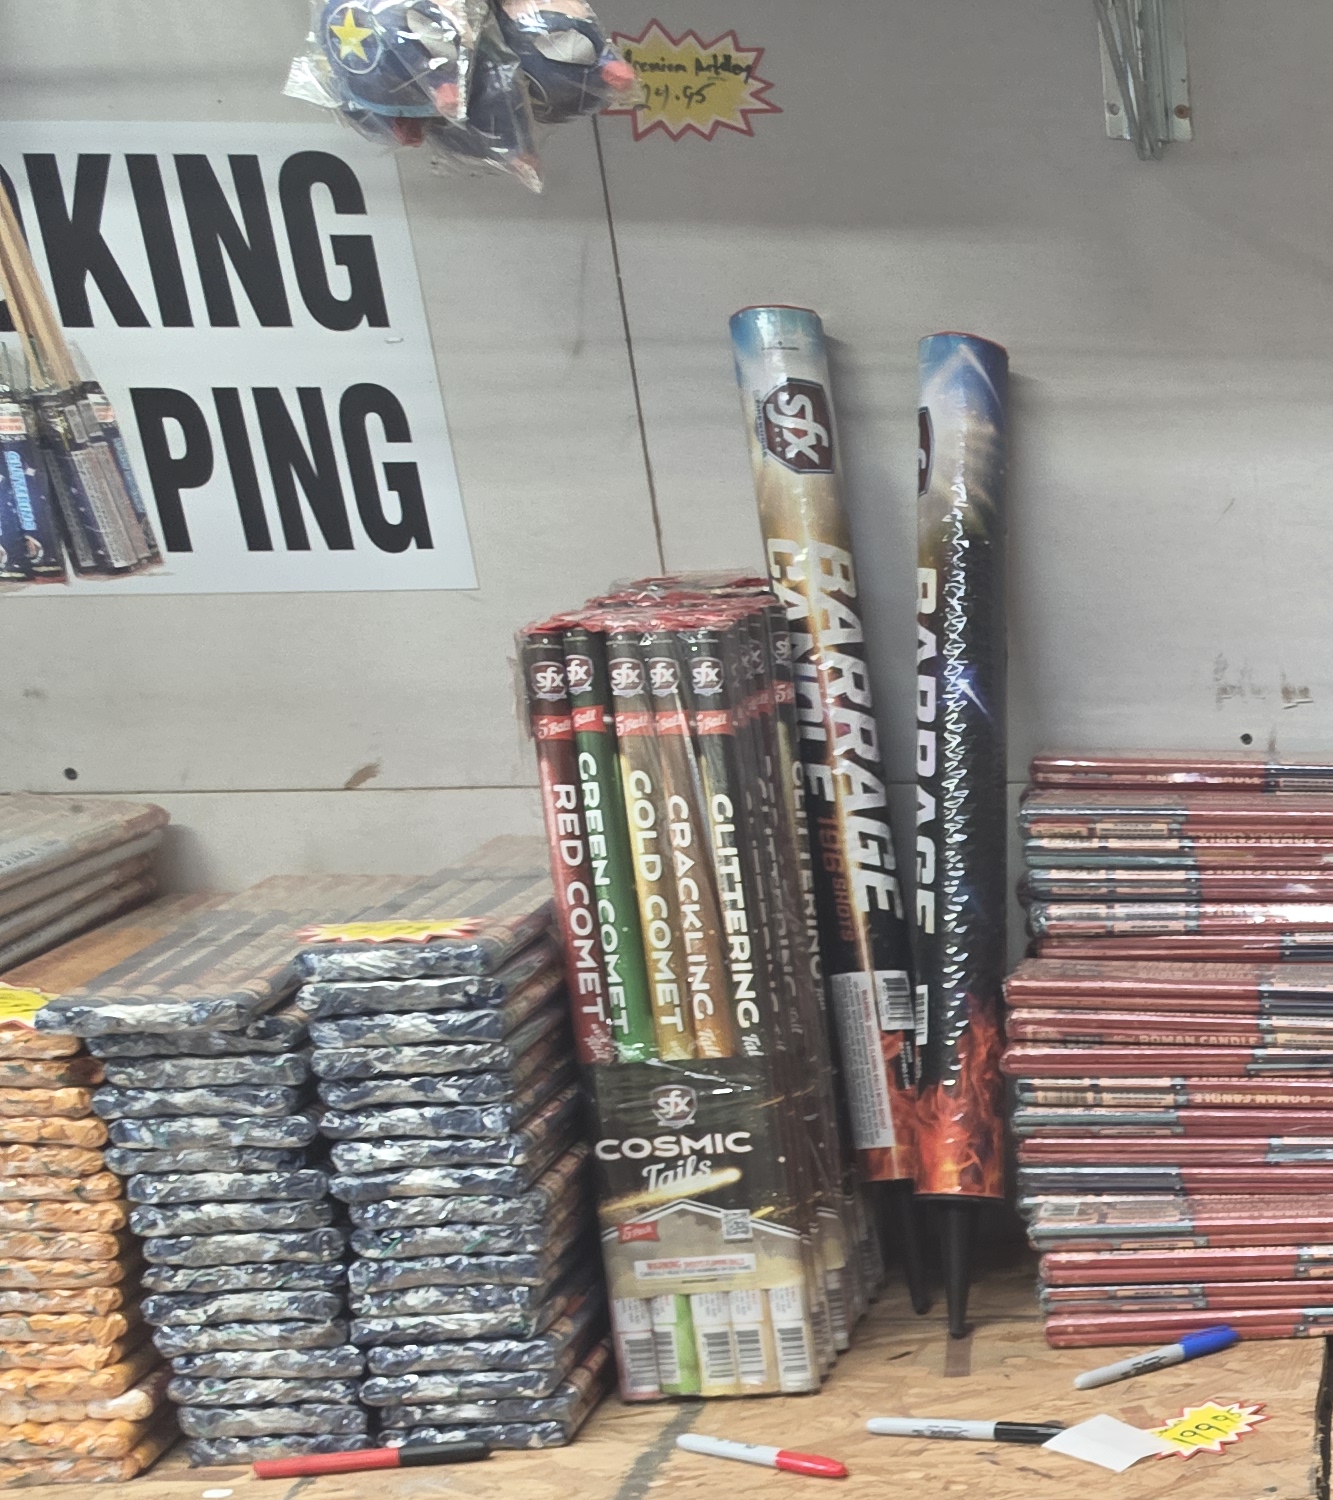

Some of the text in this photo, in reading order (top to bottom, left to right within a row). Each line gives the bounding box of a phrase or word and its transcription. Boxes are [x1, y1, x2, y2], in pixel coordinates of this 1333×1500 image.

[0, 150, 389, 331] KING
[765, 393, 829, 465] sfx
[536, 665, 565, 693] sfx
[611, 661, 641, 691] sfx
[692, 661, 719, 690] sfx
[808, 539, 904, 922] BARRAGE
[552, 783, 583, 867] RED
[578, 751, 611, 887] GREEN
[597, 899, 630, 1034] COMET
[628, 769, 684, 1033] GOLD COMET
[667, 794, 714, 1020] CRACKLING
[711, 793, 760, 1029] GLITTERING
[566, 880, 606, 1023] COMET
[594, 1131, 754, 1161] COSMIC
[656, 1089, 692, 1119] sfx
[641, 1154, 713, 1193] Tails
